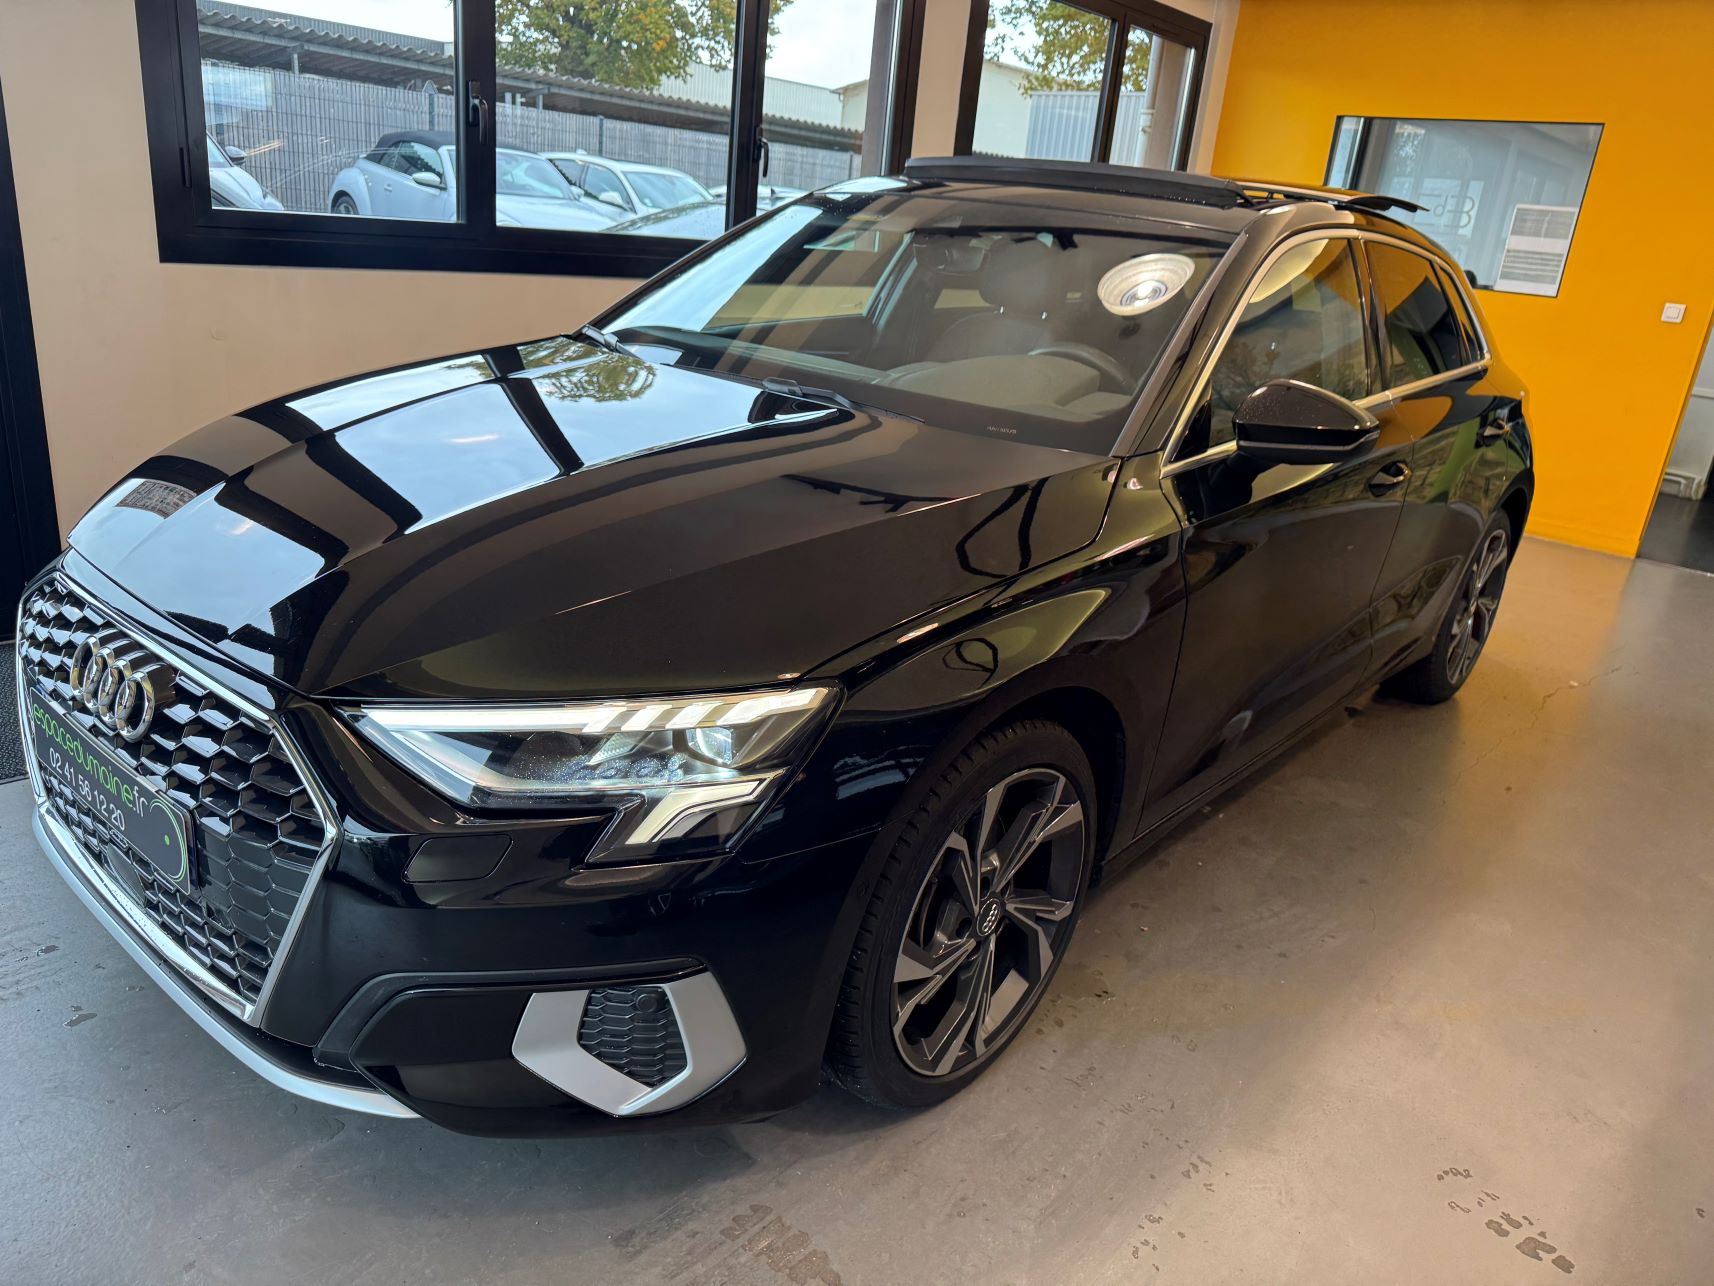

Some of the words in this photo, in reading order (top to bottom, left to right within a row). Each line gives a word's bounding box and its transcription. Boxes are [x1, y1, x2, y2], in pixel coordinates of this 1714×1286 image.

[33, 703, 148, 818] espacedumaine.fr
[49, 747, 62, 775] 02
[64, 761, 76, 787] 41
[78, 773, 92, 802] 56
[94, 789, 109, 817] 12
[109, 803, 125, 832] 20
